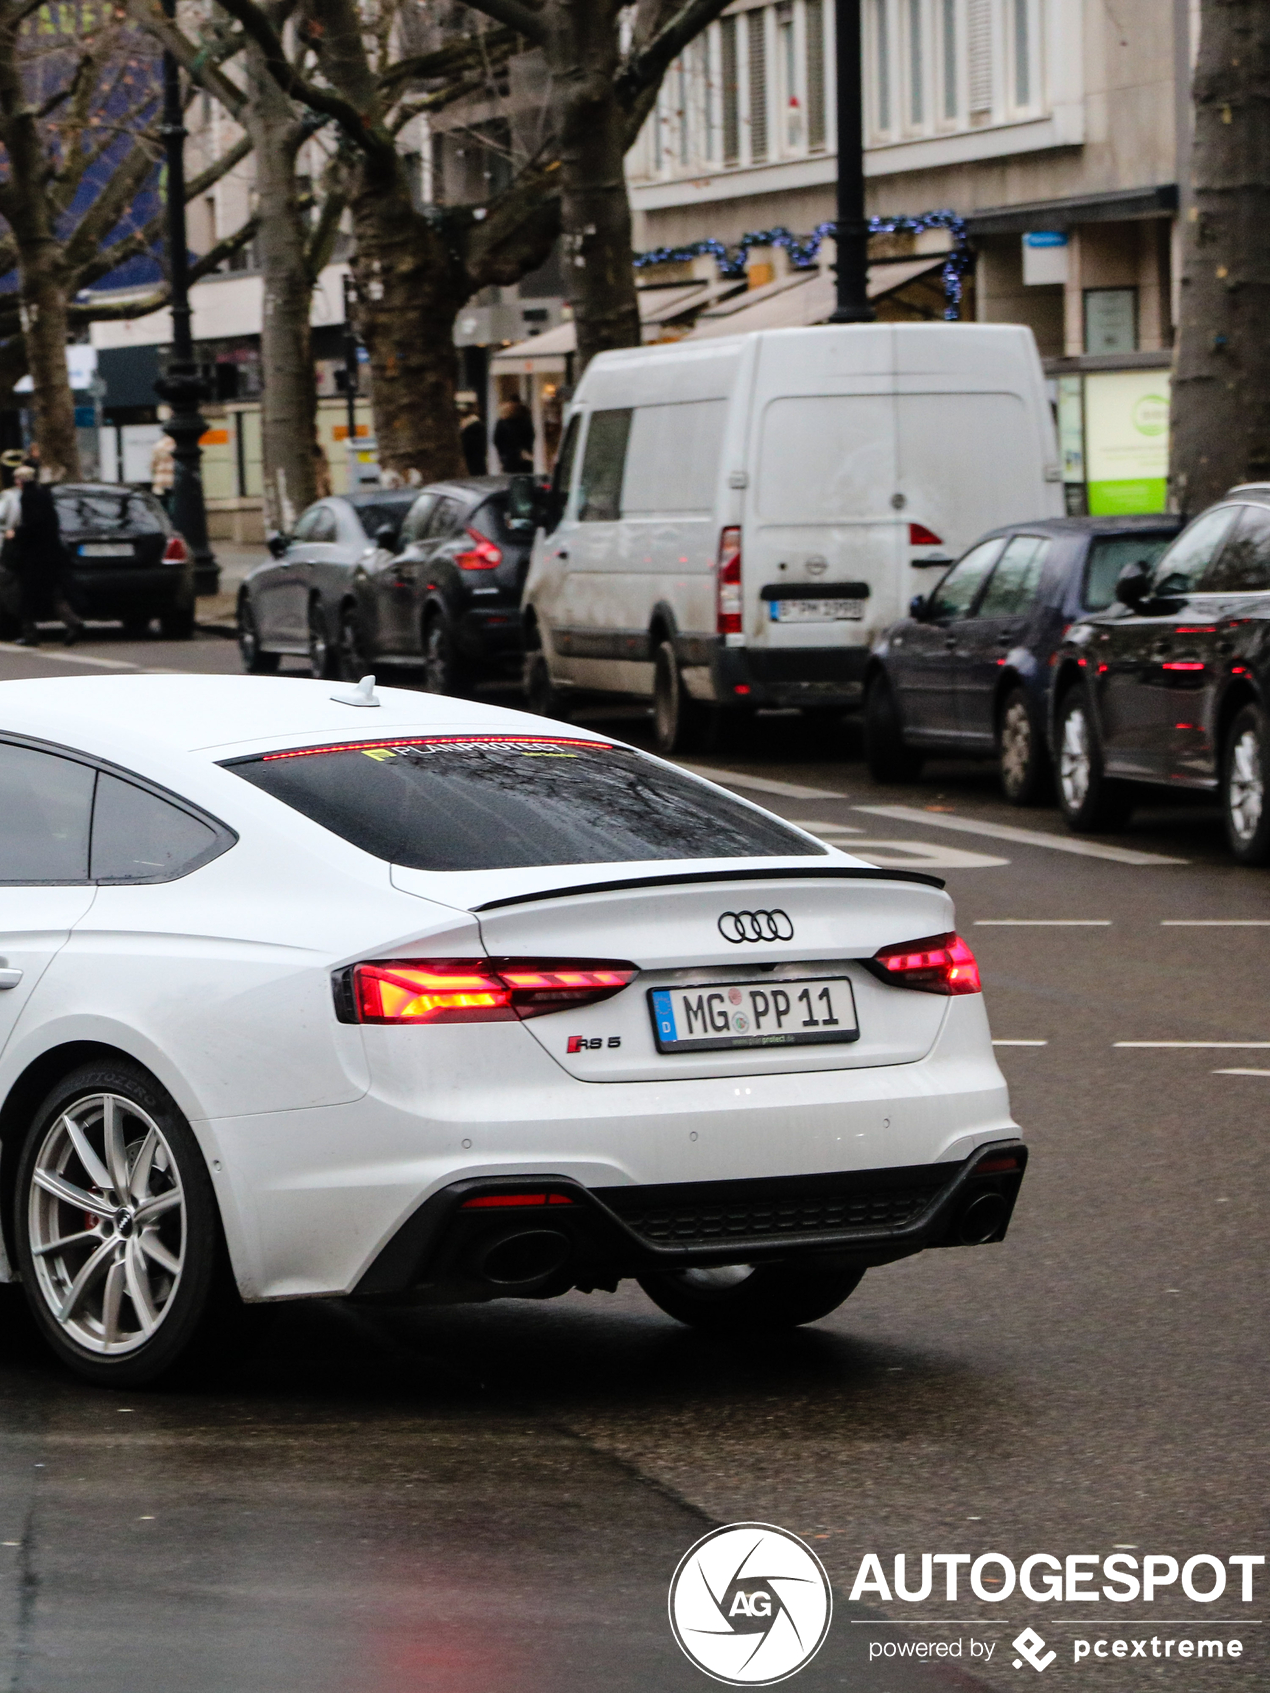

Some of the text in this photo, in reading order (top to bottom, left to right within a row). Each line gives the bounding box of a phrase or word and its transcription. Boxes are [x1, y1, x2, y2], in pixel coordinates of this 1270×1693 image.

[391, 742, 566, 756] PLANPROTECT
[662, 986, 839, 1034] D MG PP 11
[574, 1037, 603, 1050] RS
